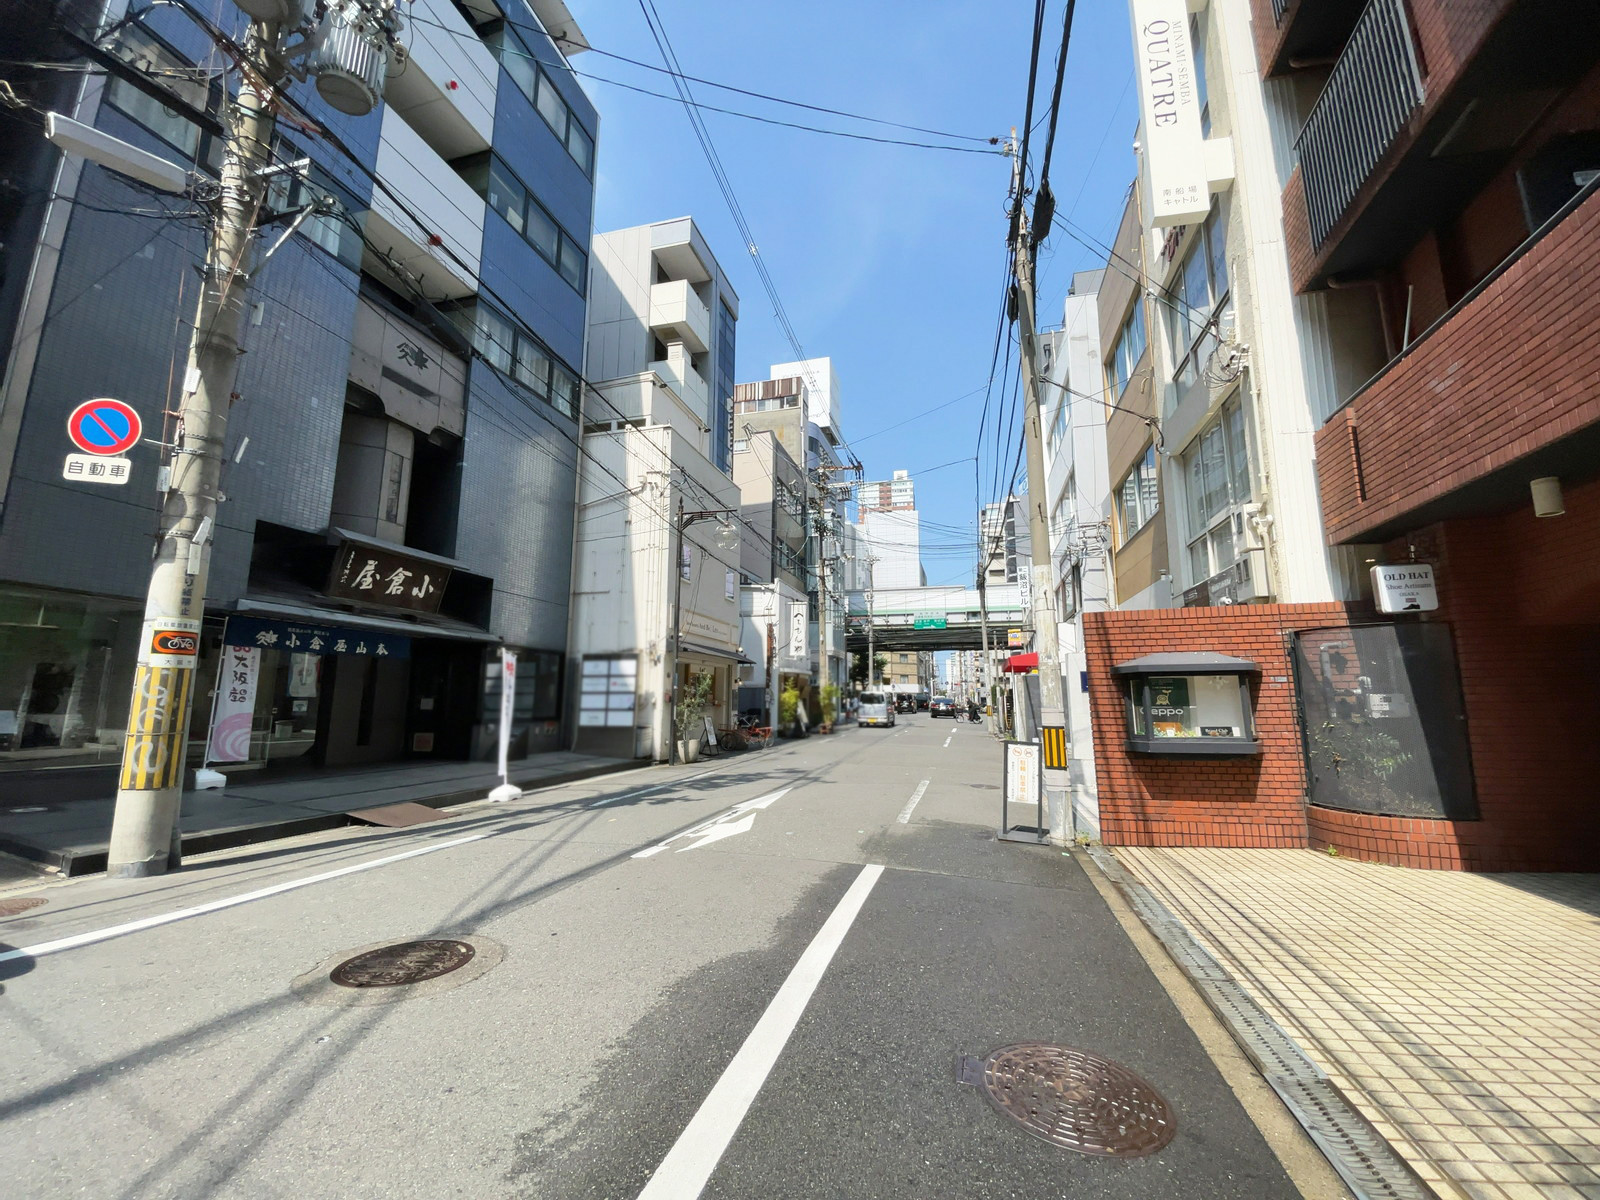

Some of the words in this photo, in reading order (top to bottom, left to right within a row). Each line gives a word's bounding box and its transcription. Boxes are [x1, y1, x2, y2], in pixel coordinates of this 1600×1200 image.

[1143, 19, 1178, 128] QUATRE
[1163, 185, 1198, 197] 南船場
[1163, 196, 1198, 206] キャトル
[67, 461, 126, 478] 自動車
[1408, 571, 1429, 580] HAT
[286, 632, 389, 656] 小倉屋山本
